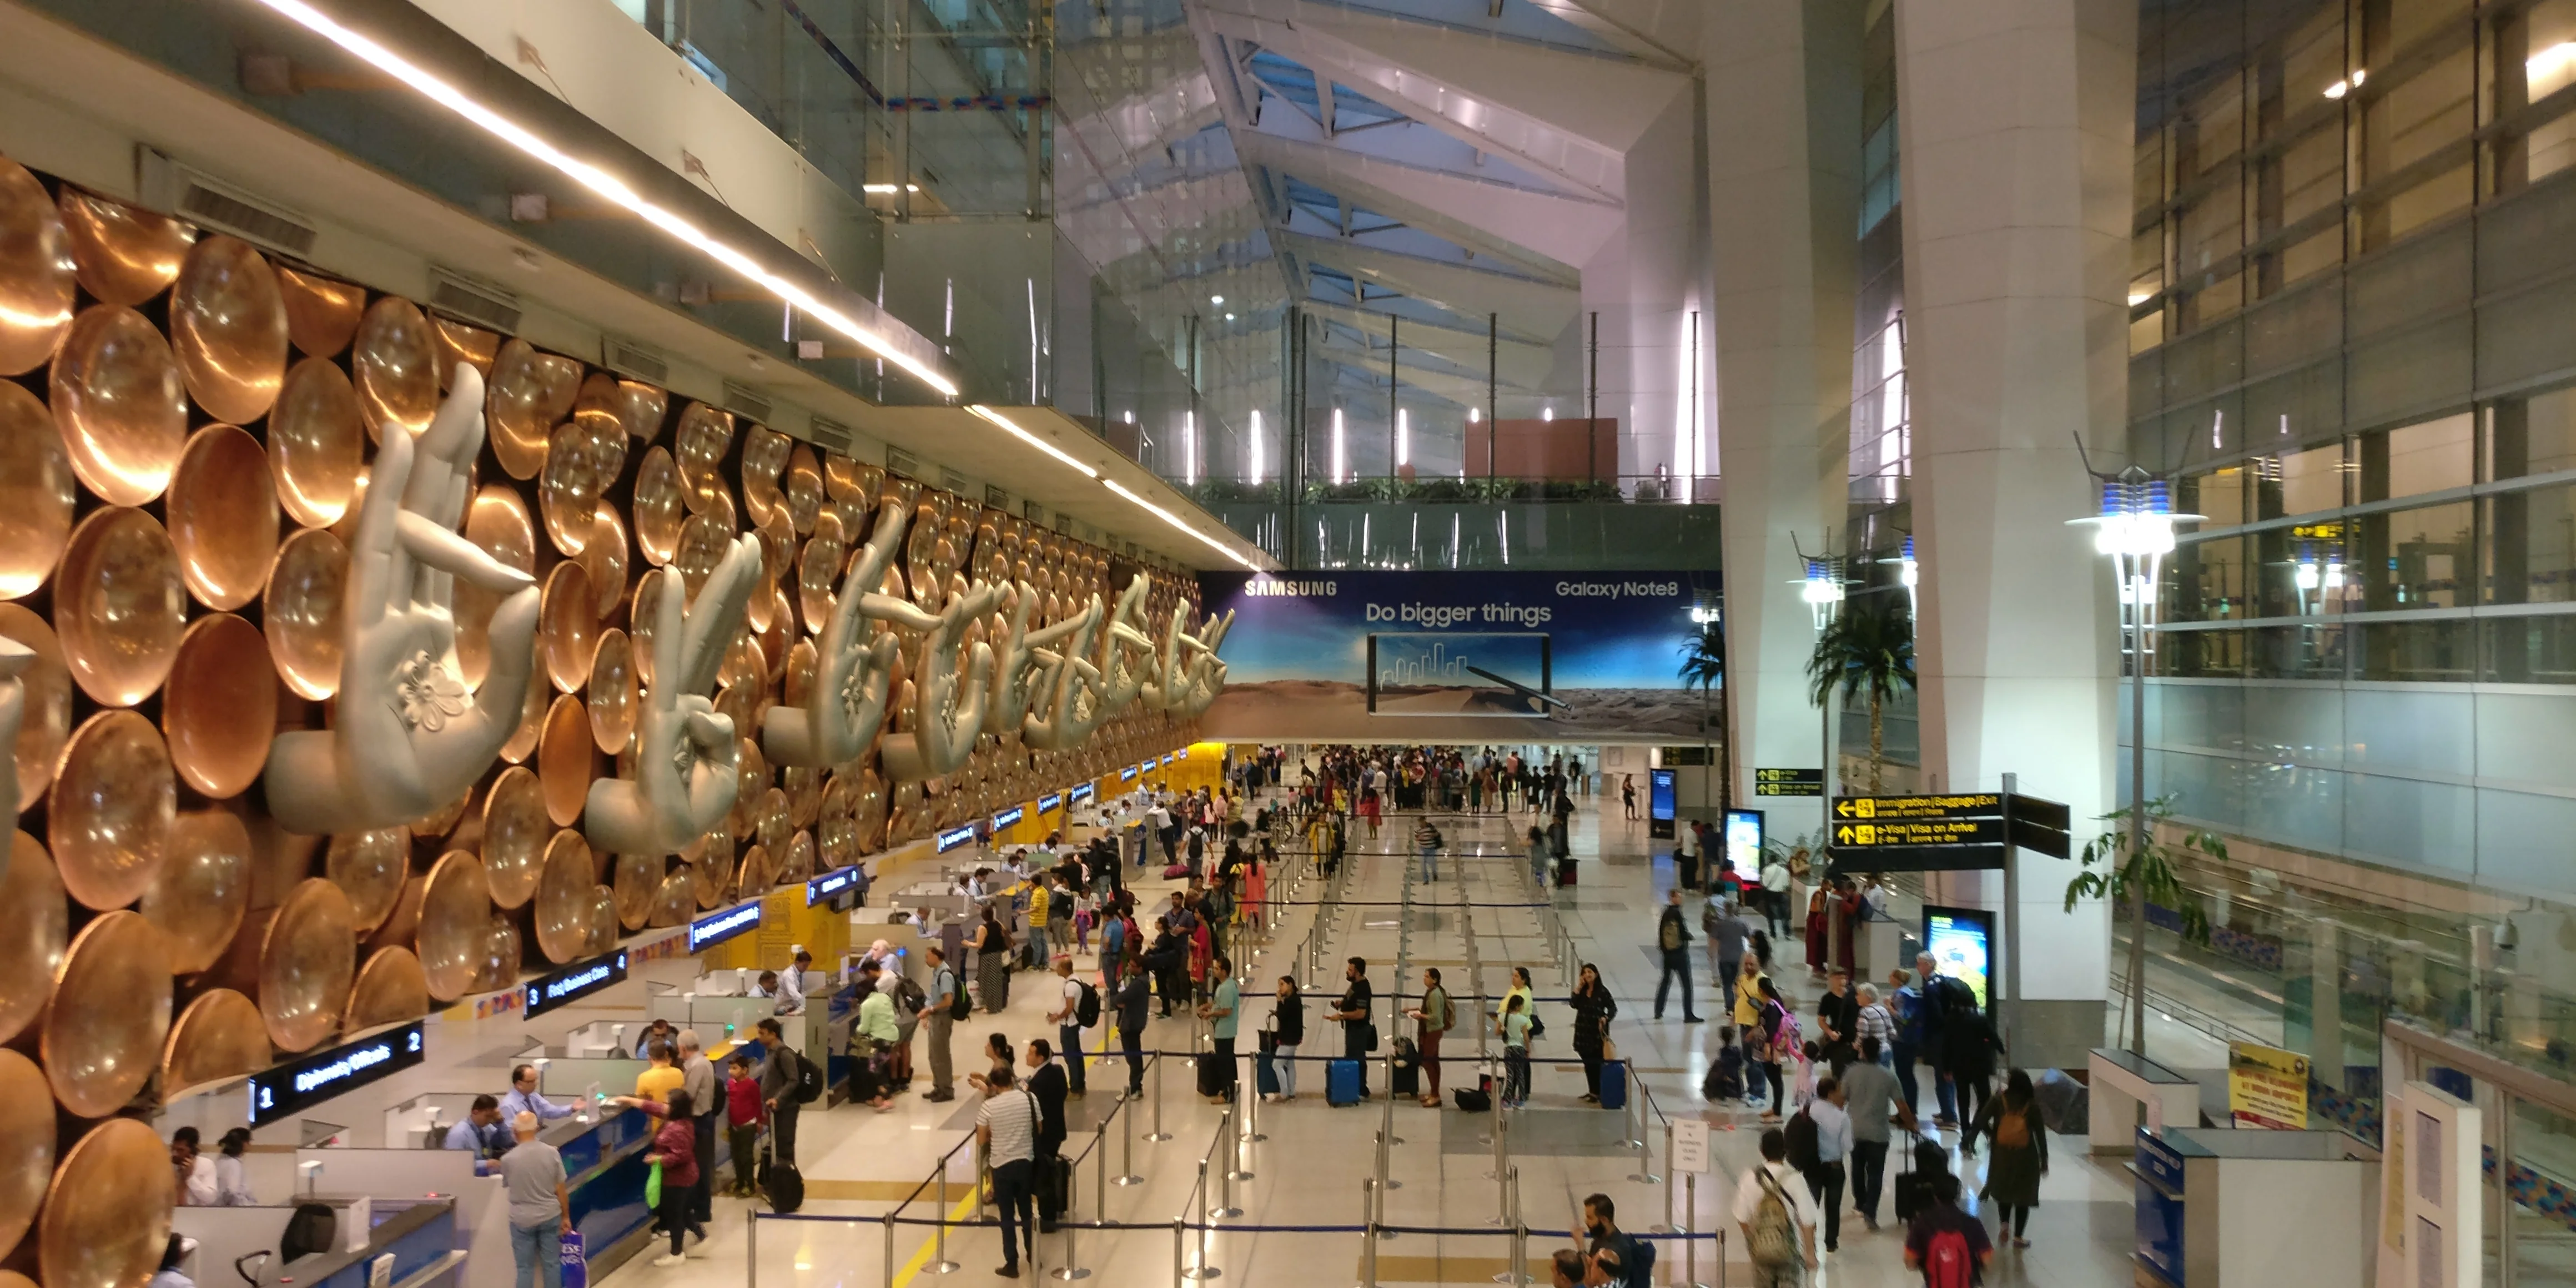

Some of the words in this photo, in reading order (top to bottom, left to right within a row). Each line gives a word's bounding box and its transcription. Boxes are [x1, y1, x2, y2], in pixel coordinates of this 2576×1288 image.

[1245, 580, 1337, 596] SAMSUNG
[1556, 581, 1621, 600] Galaxy
[1623, 581, 1678, 596] Note8
[1366, 603, 1395, 621] Do
[1401, 601, 1476, 627] bigger
[1481, 602, 1552, 627] things
[1909, 823, 1931, 833] Visa
[1933, 824, 1946, 833] on
[1947, 822, 1977, 832] Arrival
[529, 988, 539, 1005] 3
[617, 954, 625, 969] 4
[259, 1086, 274, 1108] 1
[408, 1032, 421, 1052] 2
